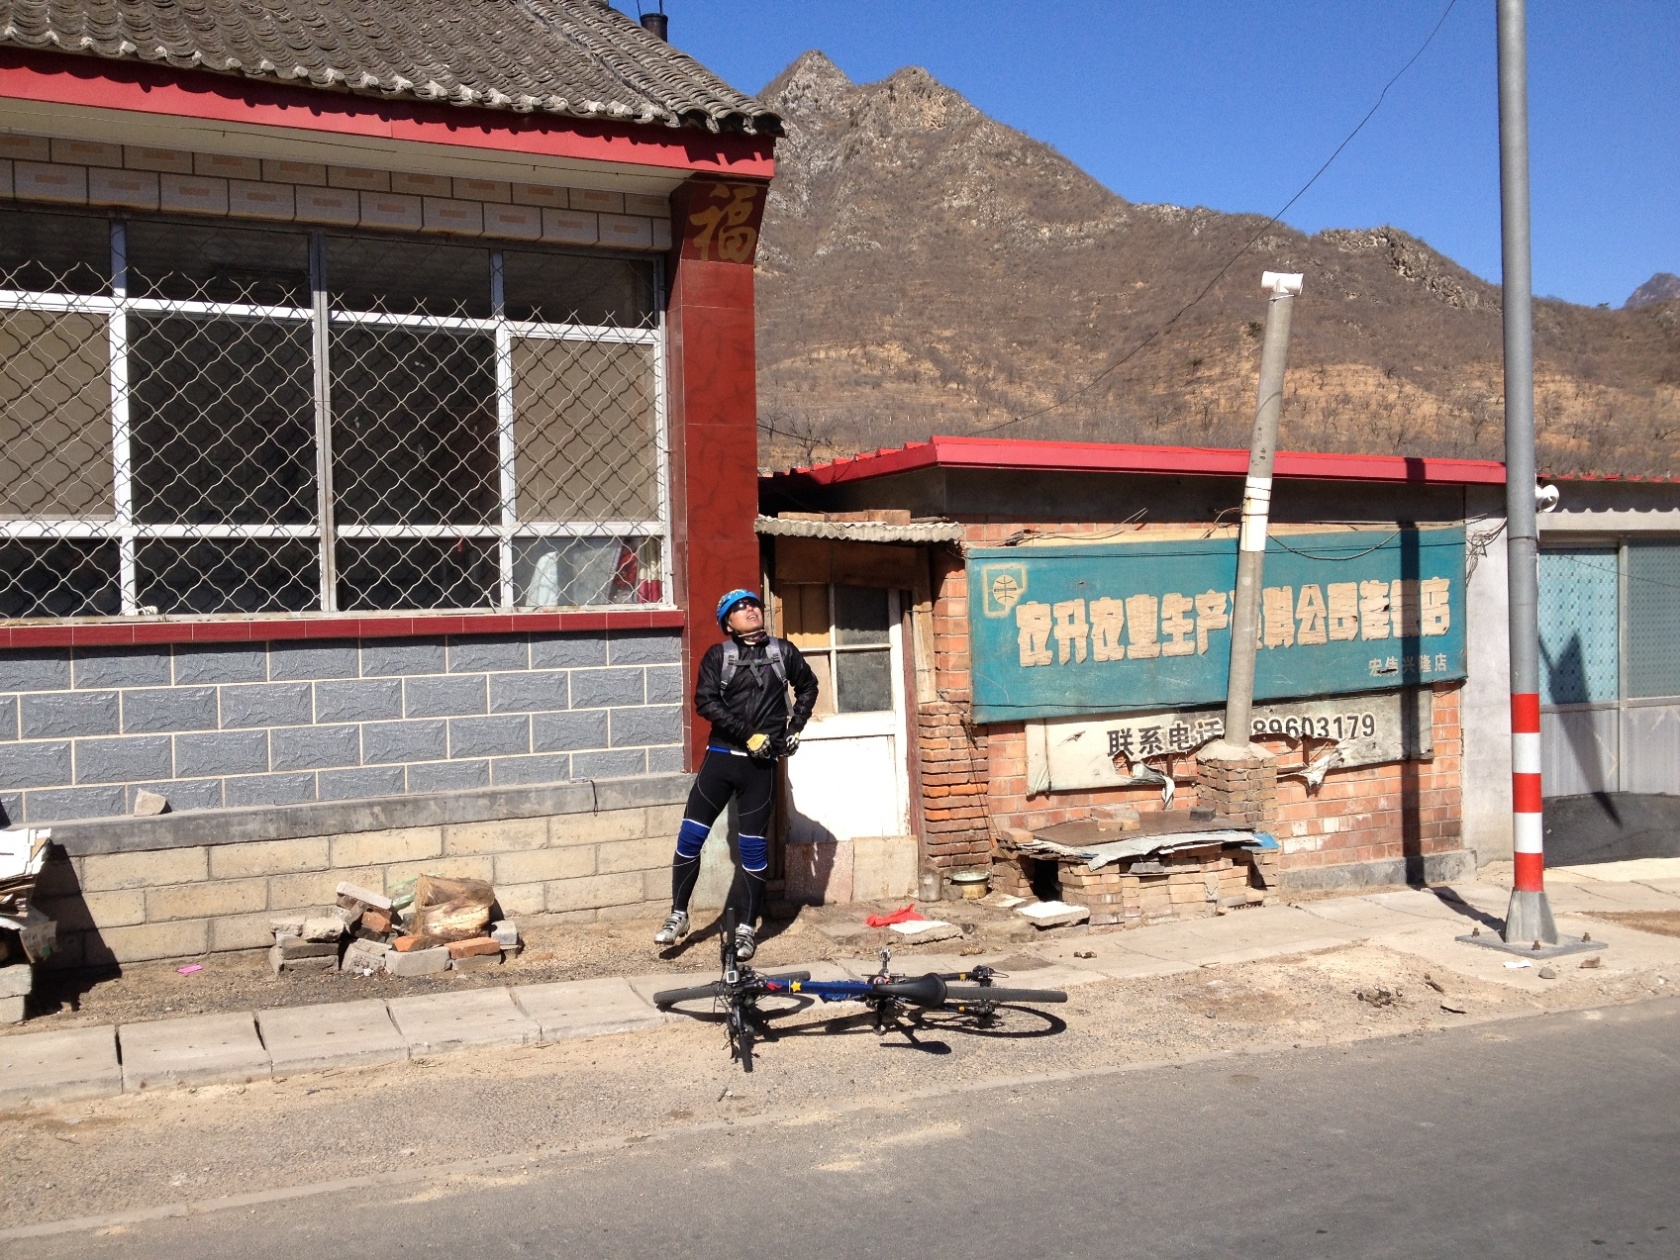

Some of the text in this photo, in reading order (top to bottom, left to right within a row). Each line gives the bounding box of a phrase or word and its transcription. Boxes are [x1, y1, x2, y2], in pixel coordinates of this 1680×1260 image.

[689, 183, 757, 263] 福
[1016, 576, 1451, 667] 农升农业生产料公司连锁店
[1252, 713, 1375, 740] 89603179
